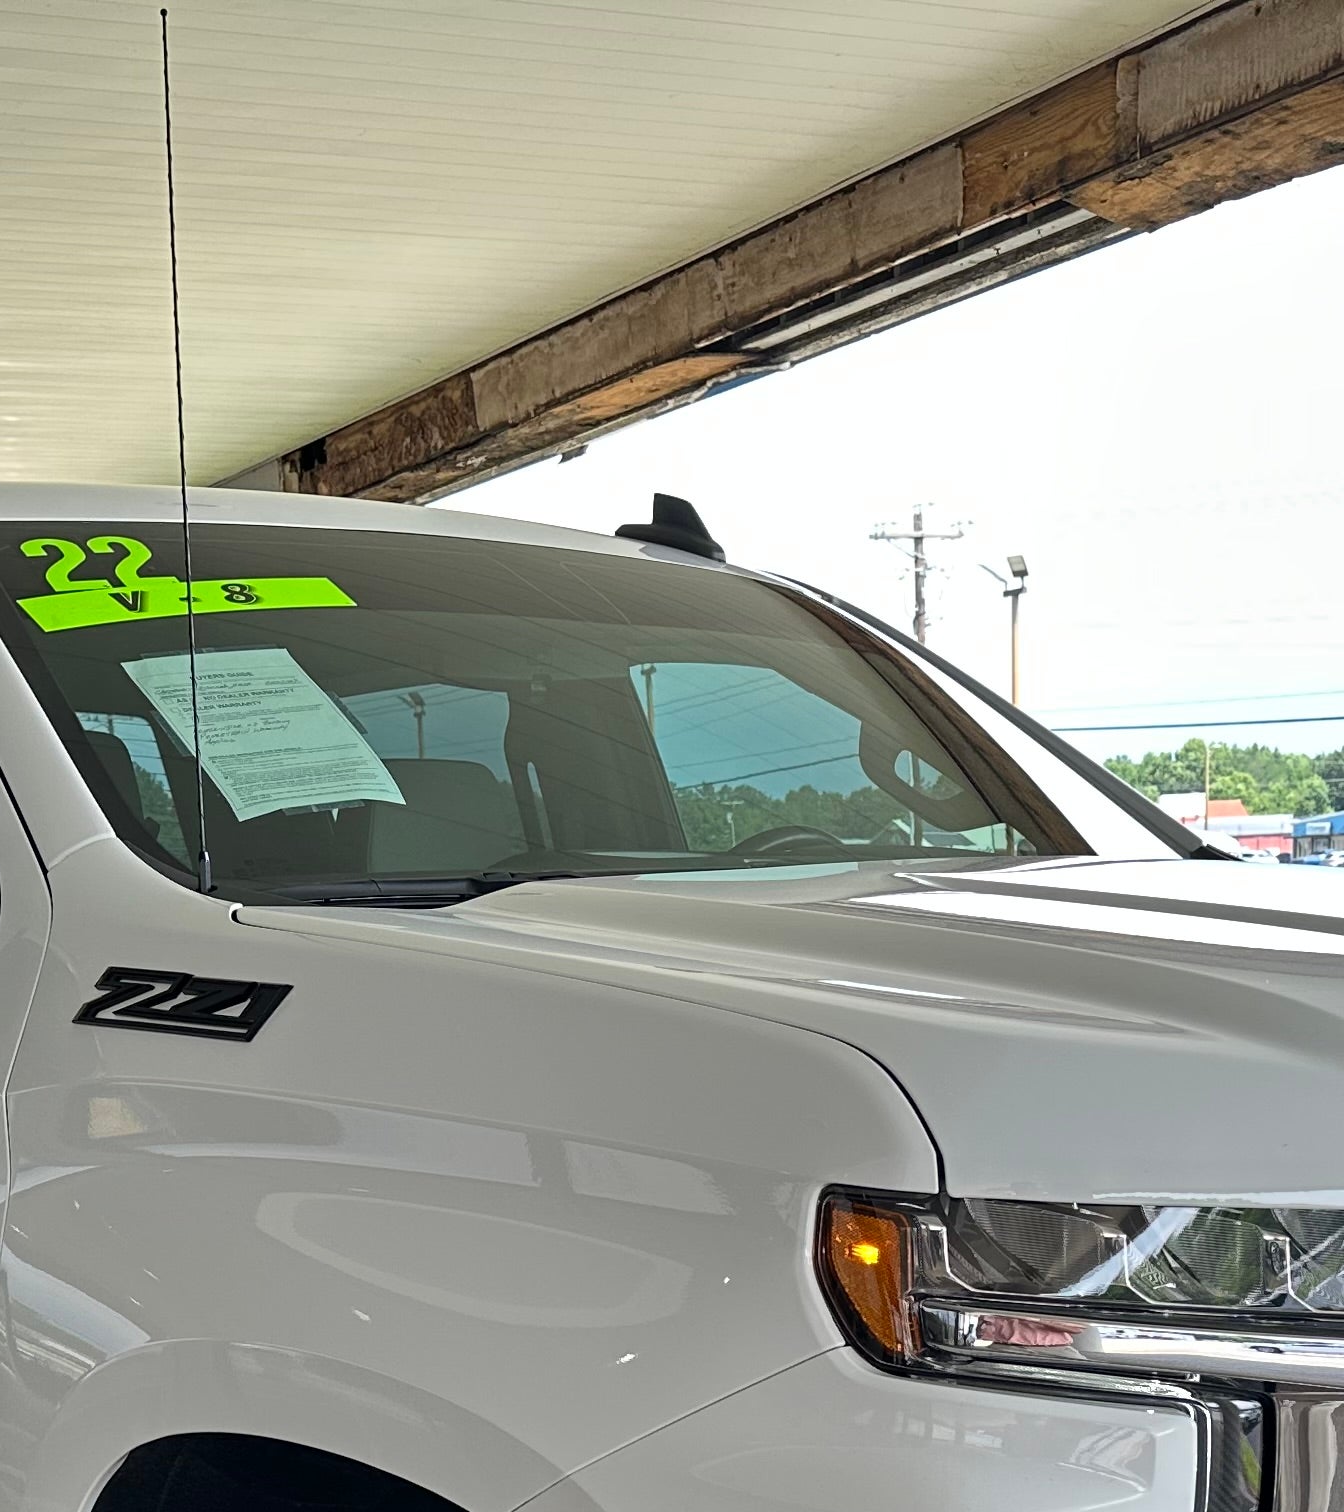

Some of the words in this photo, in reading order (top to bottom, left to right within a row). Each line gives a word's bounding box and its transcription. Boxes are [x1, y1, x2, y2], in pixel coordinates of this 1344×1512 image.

[20, 536, 178, 592] 22
[108, 590, 147, 613] V
[223, 582, 260, 606] 8
[72, 966, 294, 1043] Z71
